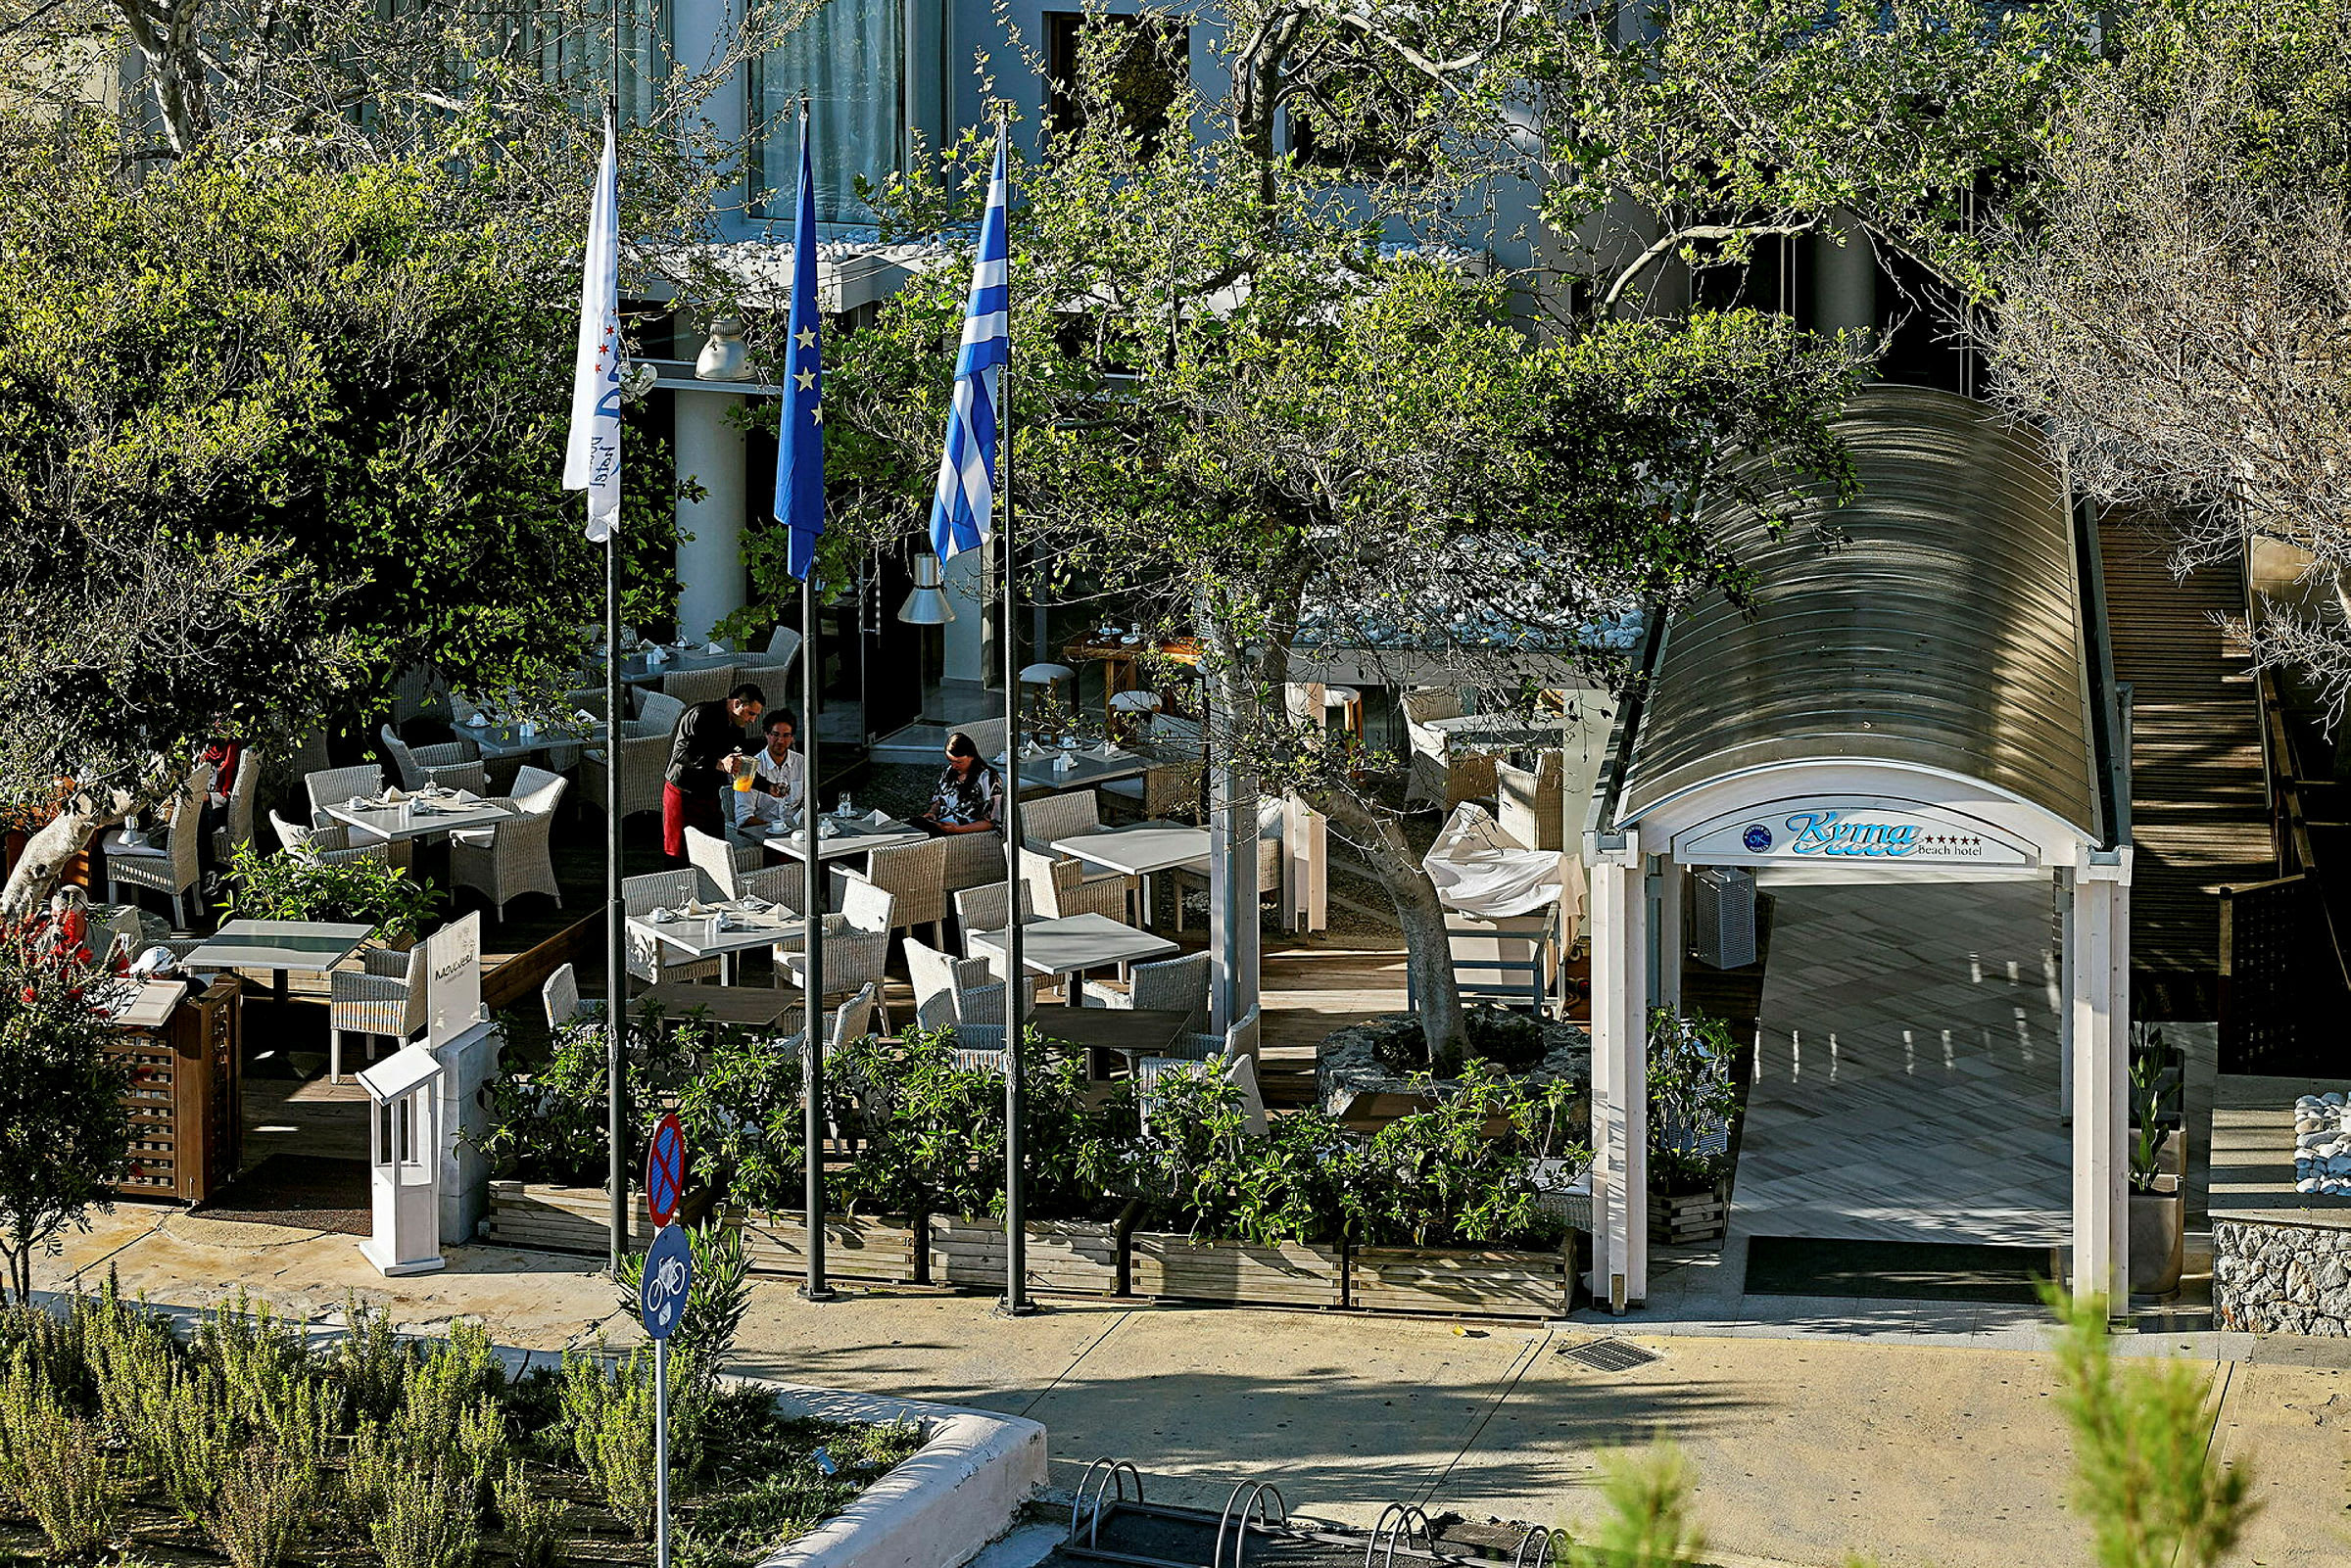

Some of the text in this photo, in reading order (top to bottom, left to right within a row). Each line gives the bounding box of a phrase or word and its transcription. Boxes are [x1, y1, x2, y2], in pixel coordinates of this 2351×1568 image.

[1785, 811, 1920, 855] Kyma
[1749, 834, 1769, 844] OK
[1954, 845, 1983, 856] hotel
